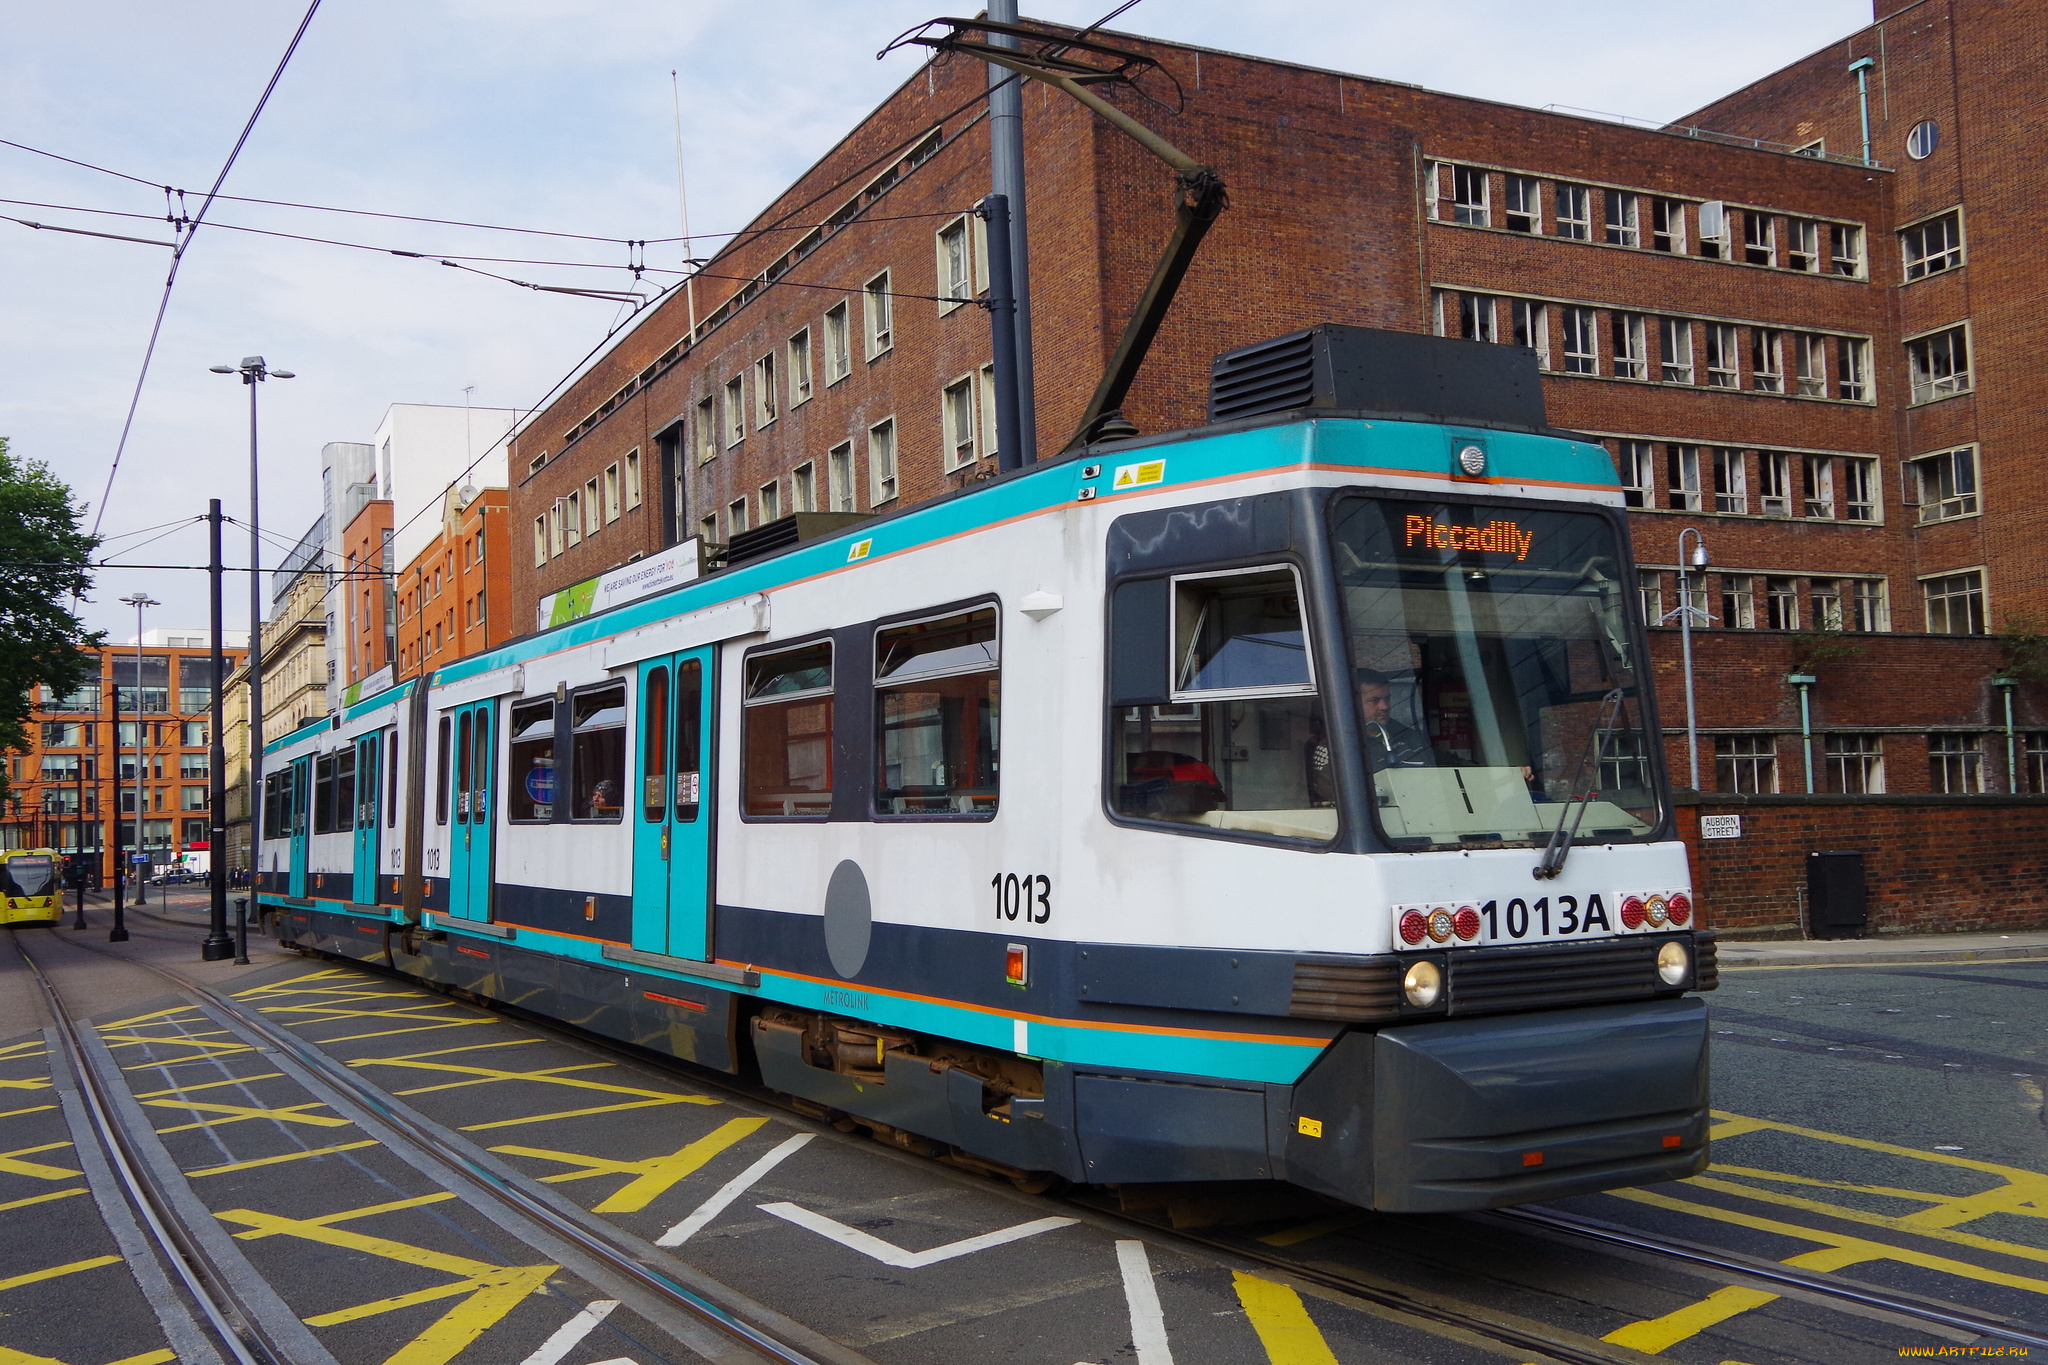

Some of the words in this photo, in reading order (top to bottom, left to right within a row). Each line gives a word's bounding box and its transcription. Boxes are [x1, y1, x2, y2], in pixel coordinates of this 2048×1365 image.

[1406, 514, 1533, 561] Piccadilly
[610, 580, 618, 590] ARE
[618, 574, 632, 588] SAVING
[632, 572, 641, 584] OUR
[641, 566, 656, 580] ENERGY
[656, 563, 666, 573] FOR
[1706, 817, 1736, 826] AUBURN
[1708, 827, 1734, 836] STREET
[427, 848, 440, 870] 1013
[991, 872, 1051, 924] 1013
[1481, 893, 1611, 940] 1013A
[823, 990, 869, 1011] METROLINK
